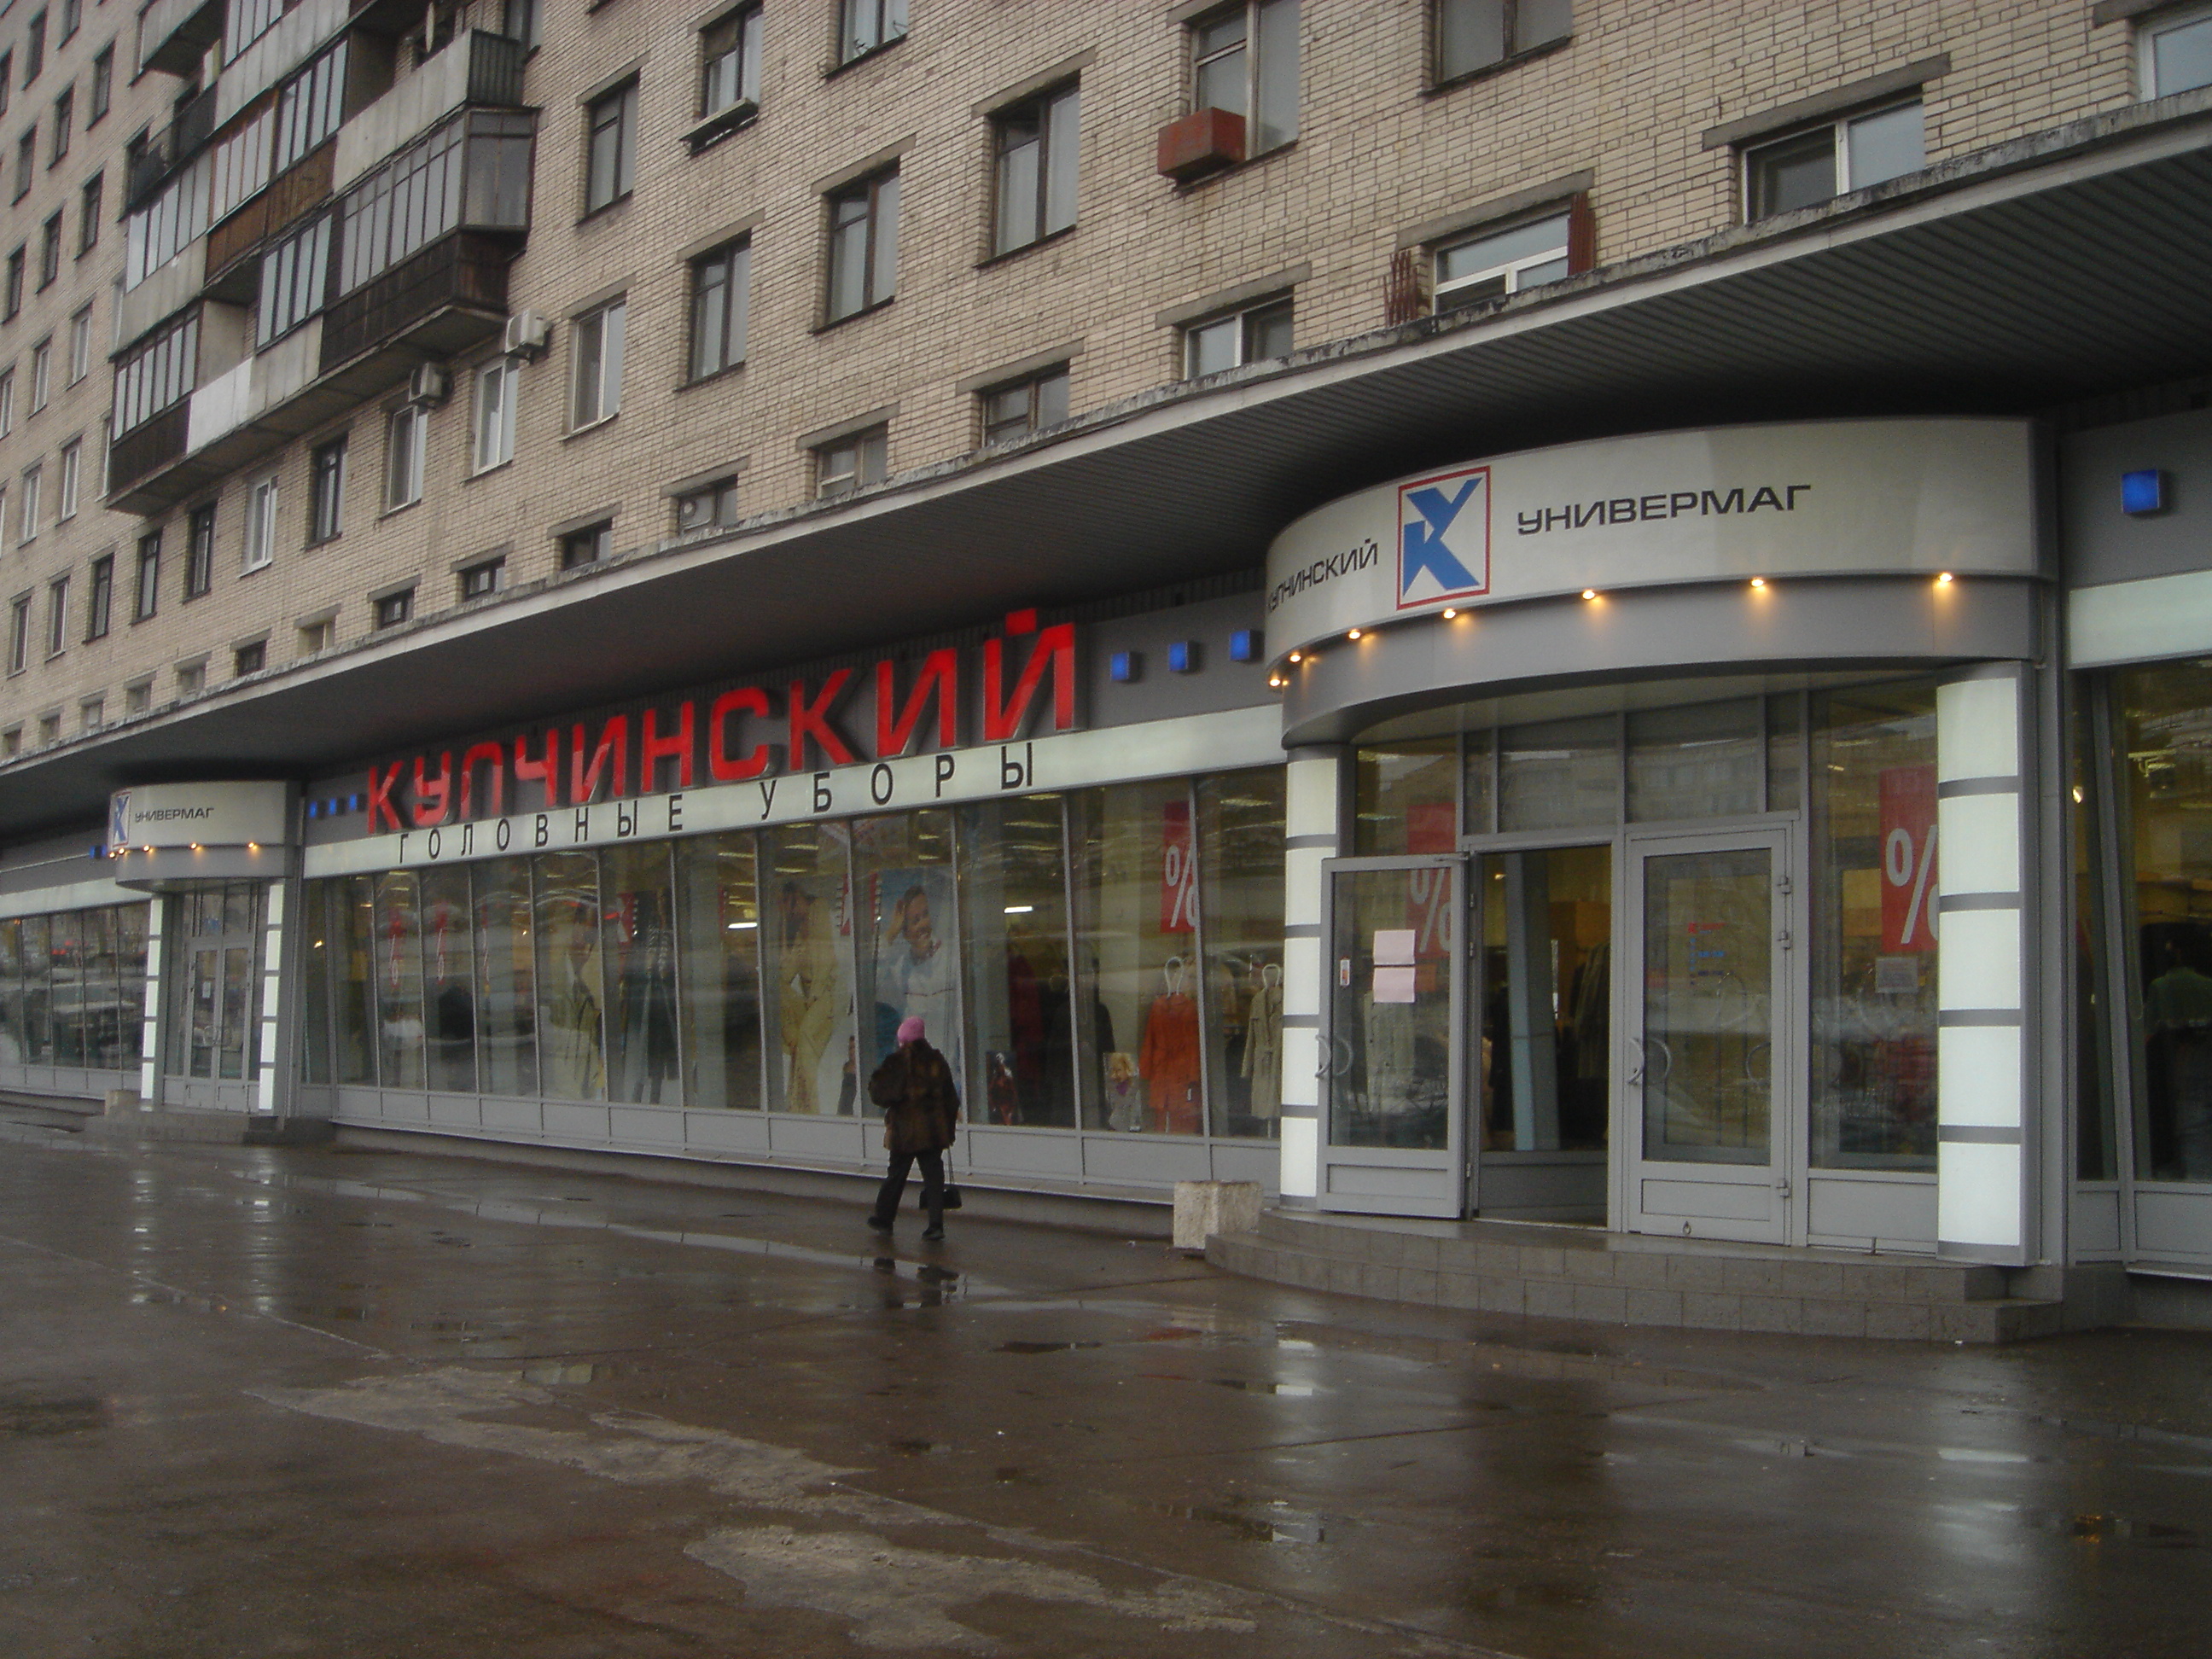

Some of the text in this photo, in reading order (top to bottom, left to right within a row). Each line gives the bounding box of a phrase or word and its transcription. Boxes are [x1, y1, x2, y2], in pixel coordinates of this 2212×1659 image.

[1267, 485, 1811, 613] УПЧИНСКИЙ УНИВЕРМАГ
[368, 607, 1075, 834] КУПЧИНСКИЙ
[135, 807, 214, 823] УНИВЕРМАГ
[399, 742, 1033, 864] ГОЛОВНЫЕ УБОРЫ
